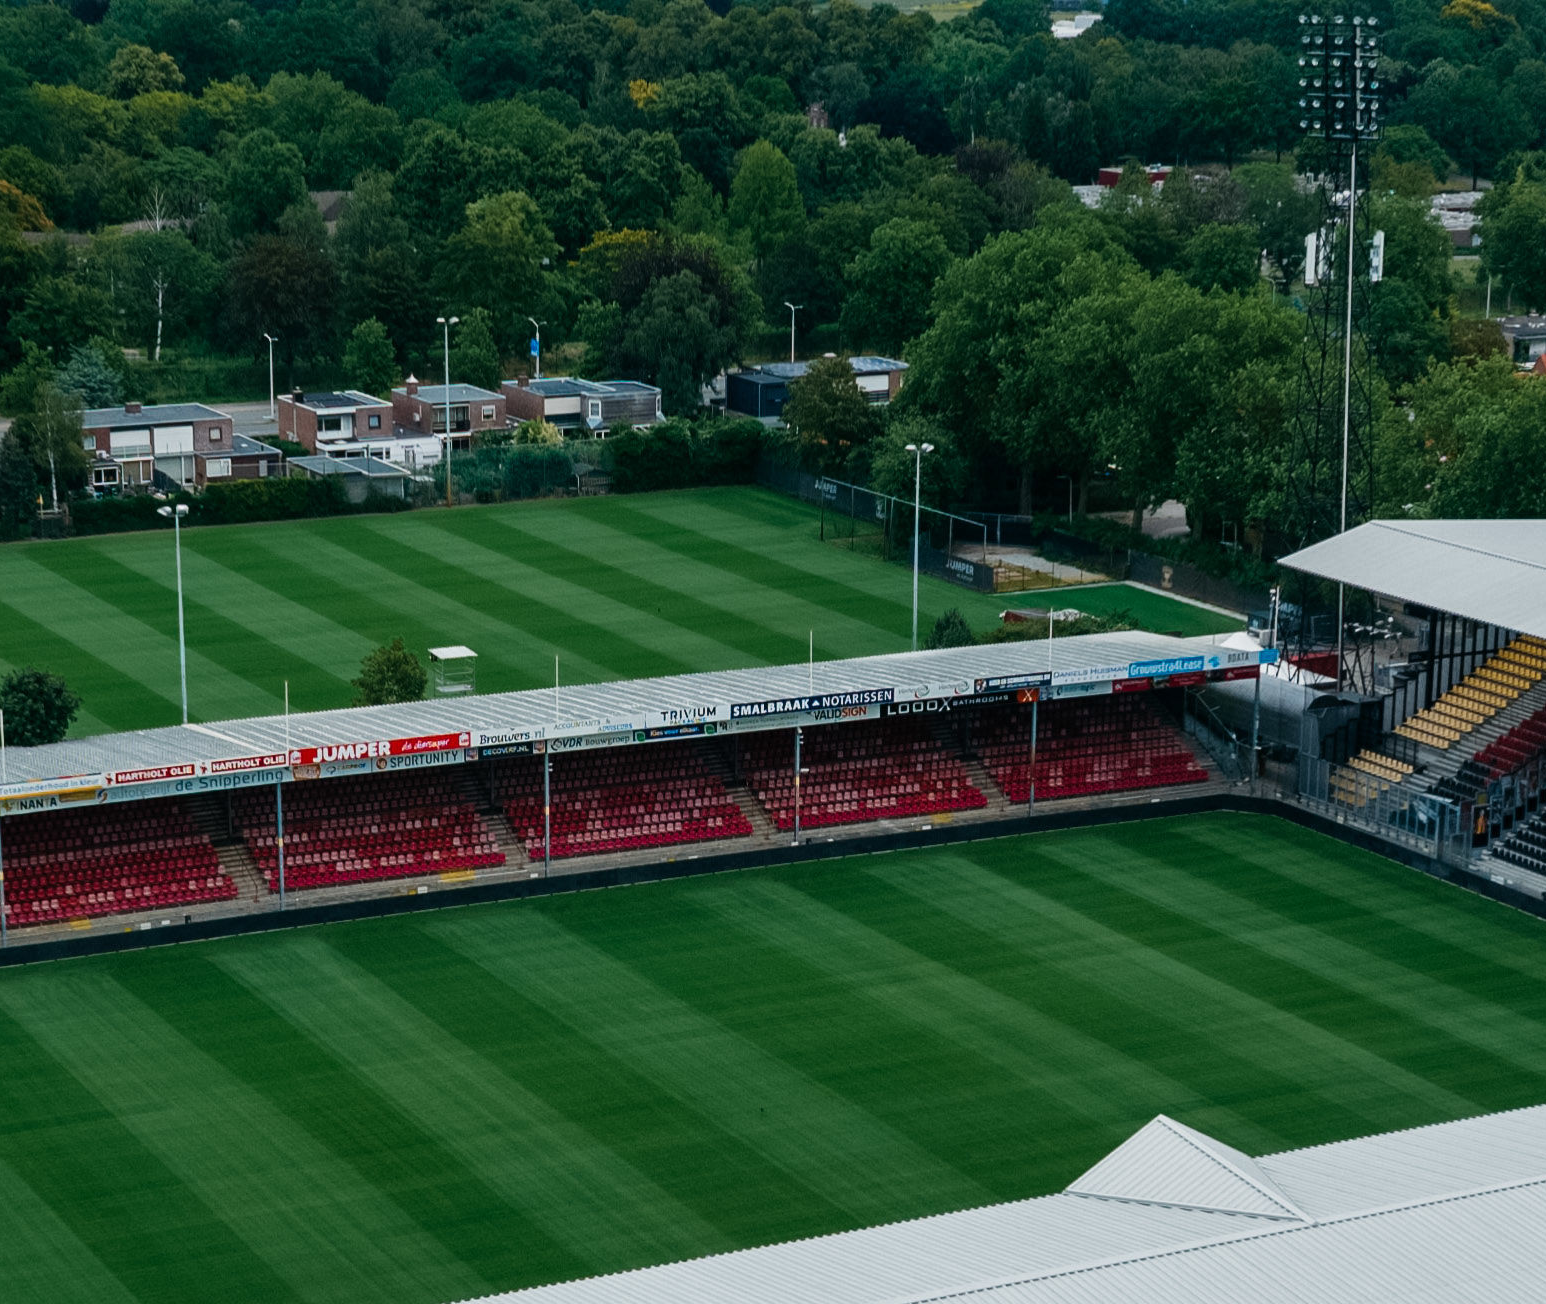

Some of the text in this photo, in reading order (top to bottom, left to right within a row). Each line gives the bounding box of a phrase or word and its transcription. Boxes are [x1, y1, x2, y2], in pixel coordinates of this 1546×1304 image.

[732, 699, 810, 717] SMALBRAAK
[822, 690, 893, 708] NOTARISSEN
[660, 706, 717, 722] TRIVIUM
[813, 705, 868, 722] VALIDSIGN
[479, 731, 531, 745] Brouwers
[312, 740, 392, 763] JUMPER
[390, 750, 460, 769] SPORTUNITY
[211, 753, 287, 772] HARTHOLT OLIE
[117, 764, 194, 783] HARTHOLT OLIE
[175, 778, 193, 792] de
[198, 769, 285, 790] Snipperling
